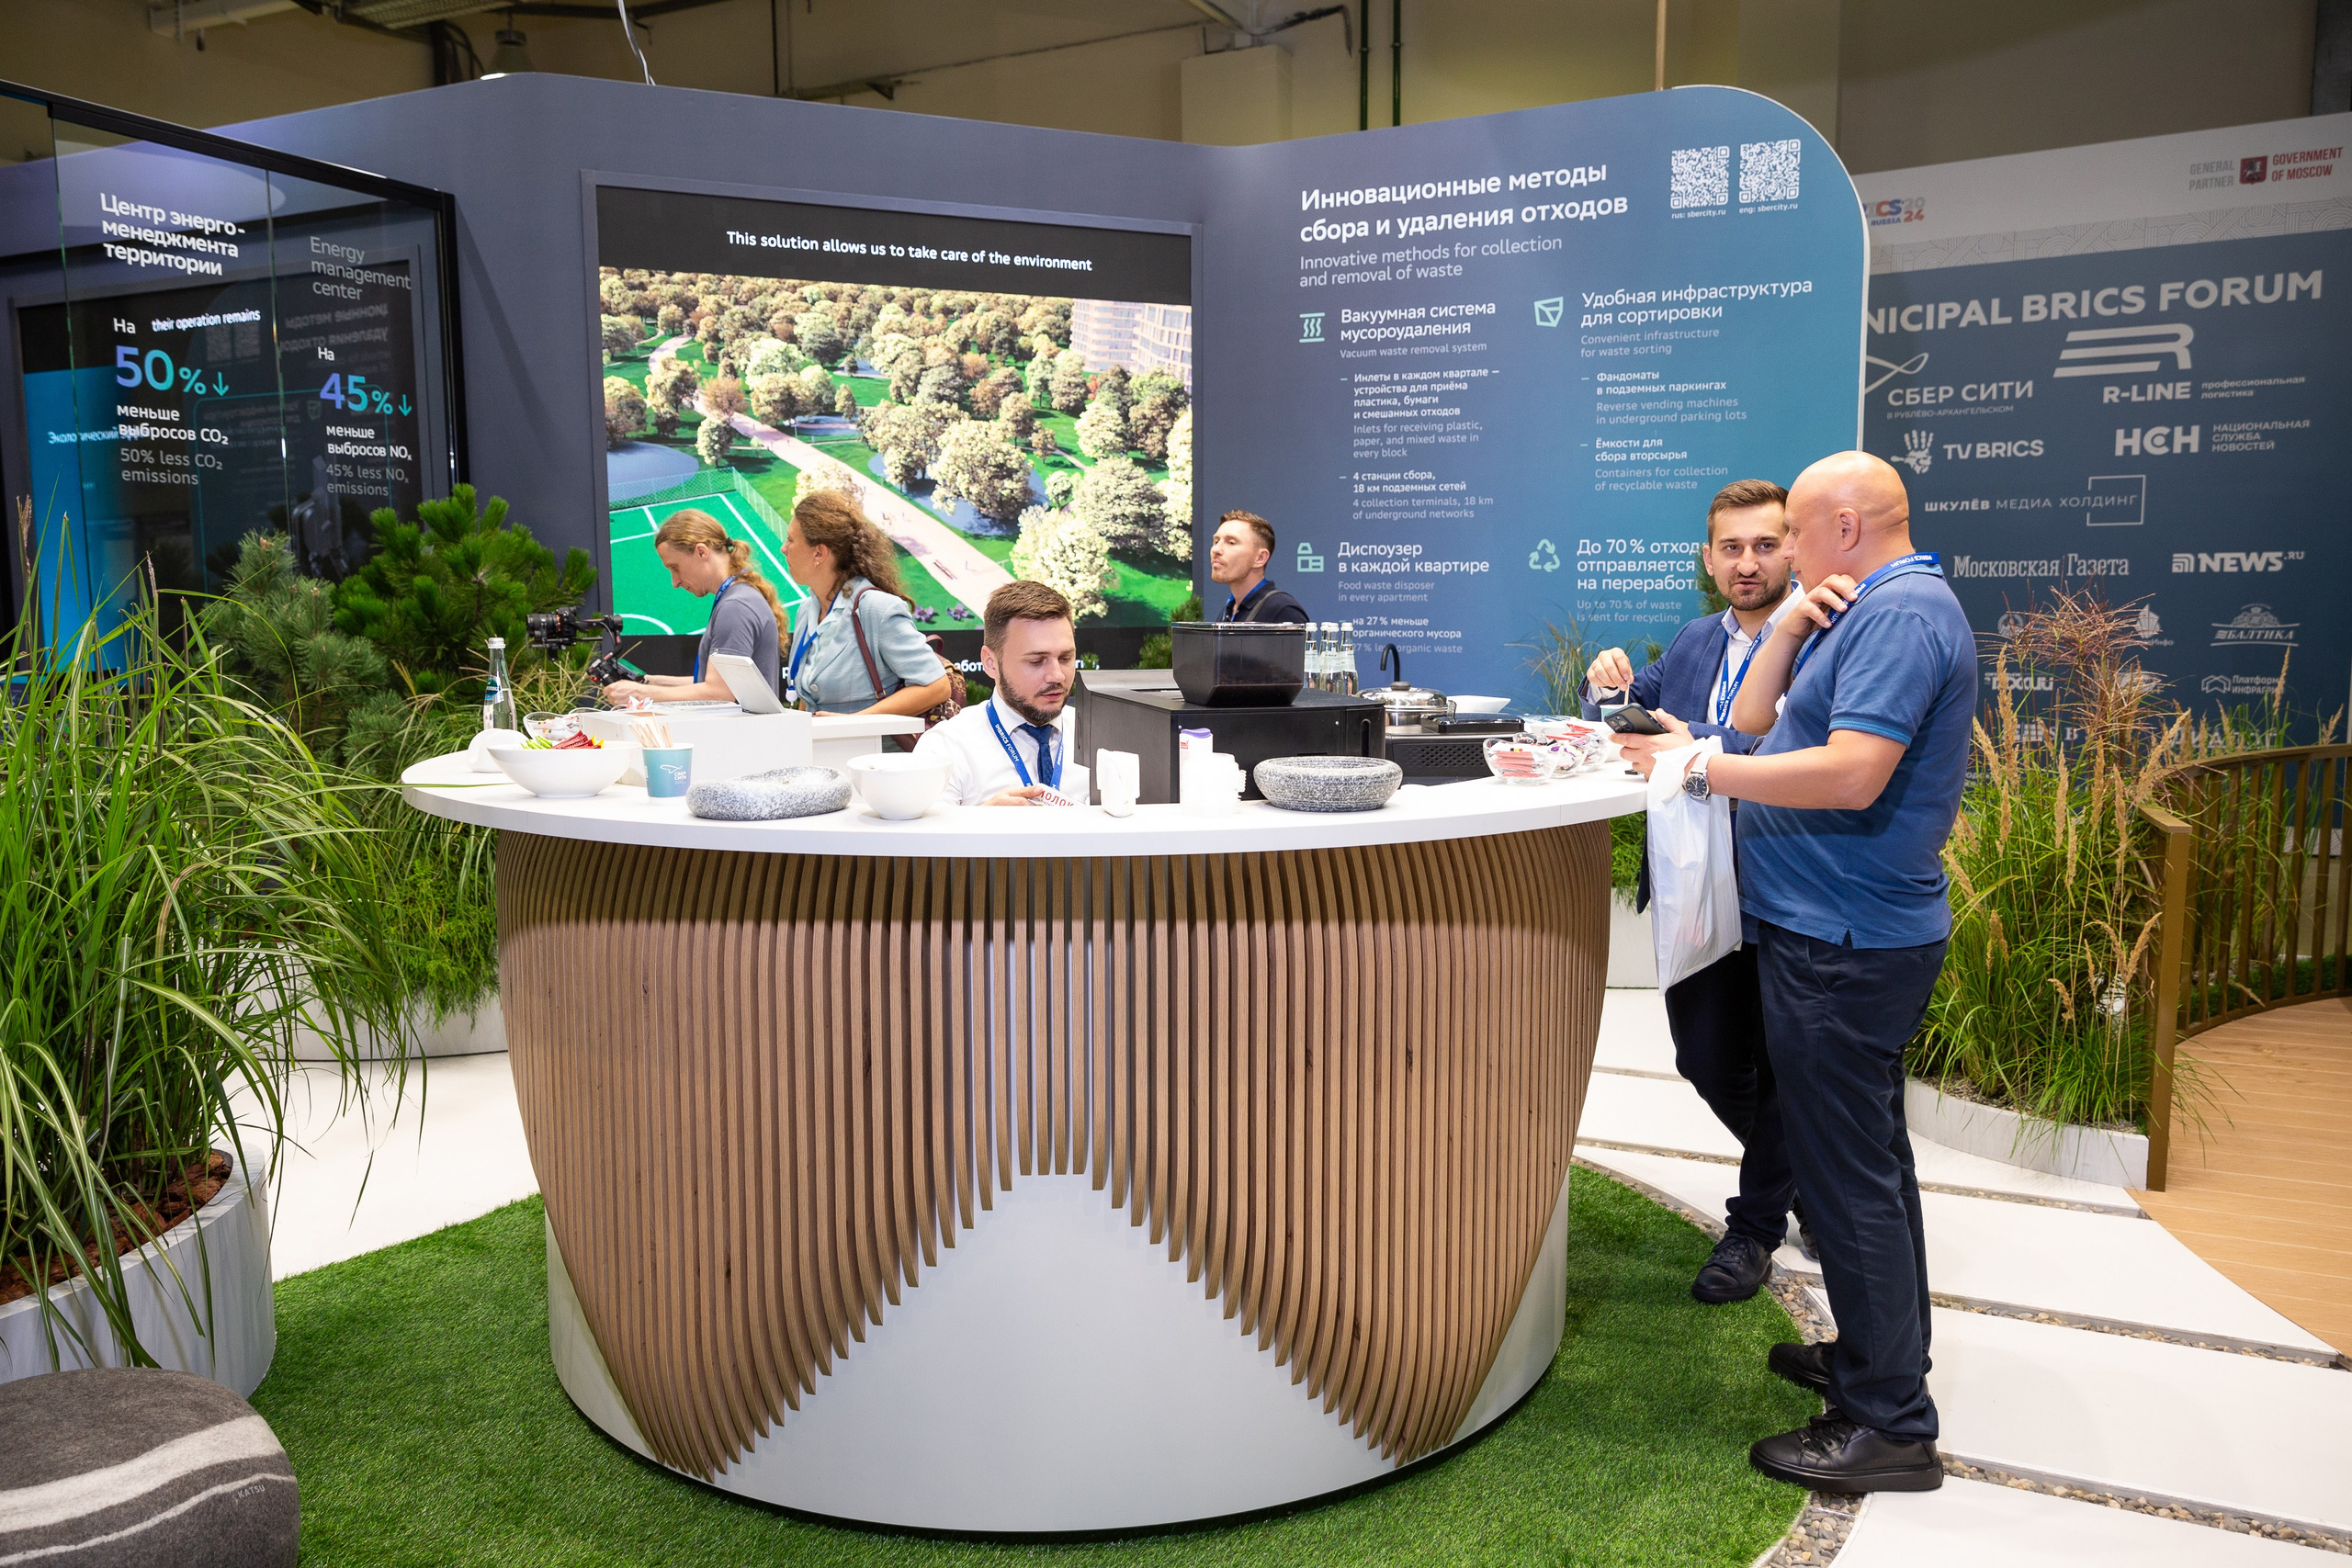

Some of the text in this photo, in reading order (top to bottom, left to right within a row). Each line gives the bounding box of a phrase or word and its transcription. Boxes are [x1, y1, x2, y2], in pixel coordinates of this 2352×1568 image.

[2273, 147, 2343, 166] GOVERNMENT
[2190, 160, 2234, 175] GENERAL
[2272, 164, 2333, 182] OF MOSCOW
[1302, 164, 1606, 211] Инновационные методы
[2189, 175, 2234, 191] PARTNER
[100, 193, 245, 235] Центр энерго-
[1687, 209, 1726, 219] sbercity.ru
[1738, 203, 1798, 215] eng: sbercity.ru
[1300, 197, 1628, 243] сбора и удаления отходов
[101, 220, 239, 258] менеджмента
[310, 236, 366, 265] Energy
[726, 231, 1093, 272] This solution allows us to take care of the environment
[1300, 235, 1562, 270] Innovative methods for collection
[103, 243, 222, 276] территории
[311, 259, 412, 290] management
[1299, 263, 1463, 288] and removal of waste
[312, 281, 363, 300] center
[1581, 280, 1812, 310] Удобная инфраструктура
[2021, 285, 2145, 322] BRICS
[2158, 270, 2324, 311] FORUM
[151, 309, 261, 333] their operation remains
[1341, 302, 1496, 325] Вакуумная система
[1580, 306, 1723, 329] для сортировки
[113, 318, 136, 334] На
[1340, 321, 1471, 344] мусороудаления
[1580, 329, 1720, 345] Convenient infrastructure
[317, 346, 334, 361] На
[1340, 343, 1487, 358] Vacuum waste removal system
[1580, 344, 1672, 358] for waste sorting
[116, 345, 207, 395] 50%
[1354, 368, 1488, 383] Инлеты в каждом квартале
[1597, 371, 1659, 382] Фандоматы
[1353, 380, 1468, 397] устройства для приёма
[1597, 381, 1726, 395] в подземных паркингах
[2201, 377, 2306, 389] профессиональная
[320, 373, 393, 415] 45%
[1888, 380, 2033, 406] СБЕР СИТИ
[2102, 382, 2192, 403] R-LINE
[2201, 389, 2254, 399] логистика
[1353, 395, 1439, 407] пластика, бумаги
[1596, 397, 1738, 412] Reverse vending machines
[117, 405, 180, 422] меньше
[1362, 410, 1419, 419] смешанных
[1420, 407, 1461, 417] отходов
[1596, 410, 1747, 425] in underground parking lots
[119, 423, 197, 441] выбросов
[326, 425, 375, 439] меньше
[1353, 420, 1483, 434] Inlets for receiving plastic,
[2213, 420, 2311, 433] НАЦИОНАЛЬНАЯ
[1353, 433, 1479, 447] paper, and mixed waste in
[1595, 437, 1663, 449] Ёмкости для
[2212, 432, 2261, 443] СЛУЖБА
[1352, 446, 1408, 459] every block
[1943, 438, 2044, 460] TV BRICS
[2212, 441, 2276, 453] НОВОСТЕЙ
[1595, 451, 1687, 463] сбора вторсырья
[122, 468, 199, 485] emissions
[1352, 469, 1436, 481] 4 станции сбора,
[327, 482, 389, 497] emissions
[1353, 483, 1365, 493] 18
[1382, 483, 1437, 493] подземных
[1439, 480, 1466, 491] сетей
[1925, 494, 2139, 513] ШКУЛЁВ МЕДИА ХОЛДИНГ
[1338, 542, 1422, 558] Диспоузер
[1339, 558, 1490, 575] в каждой квартире
[1577, 560, 1695, 575] отправляется
[1952, 553, 2130, 578] Московская Газета
[1352, 629, 1462, 639] органического мусора
[2227, 629, 2294, 639] БАЛТИКА
[1006, 742, 1020, 762] FORUM
[238, 1484, 266, 1498] KATSU
